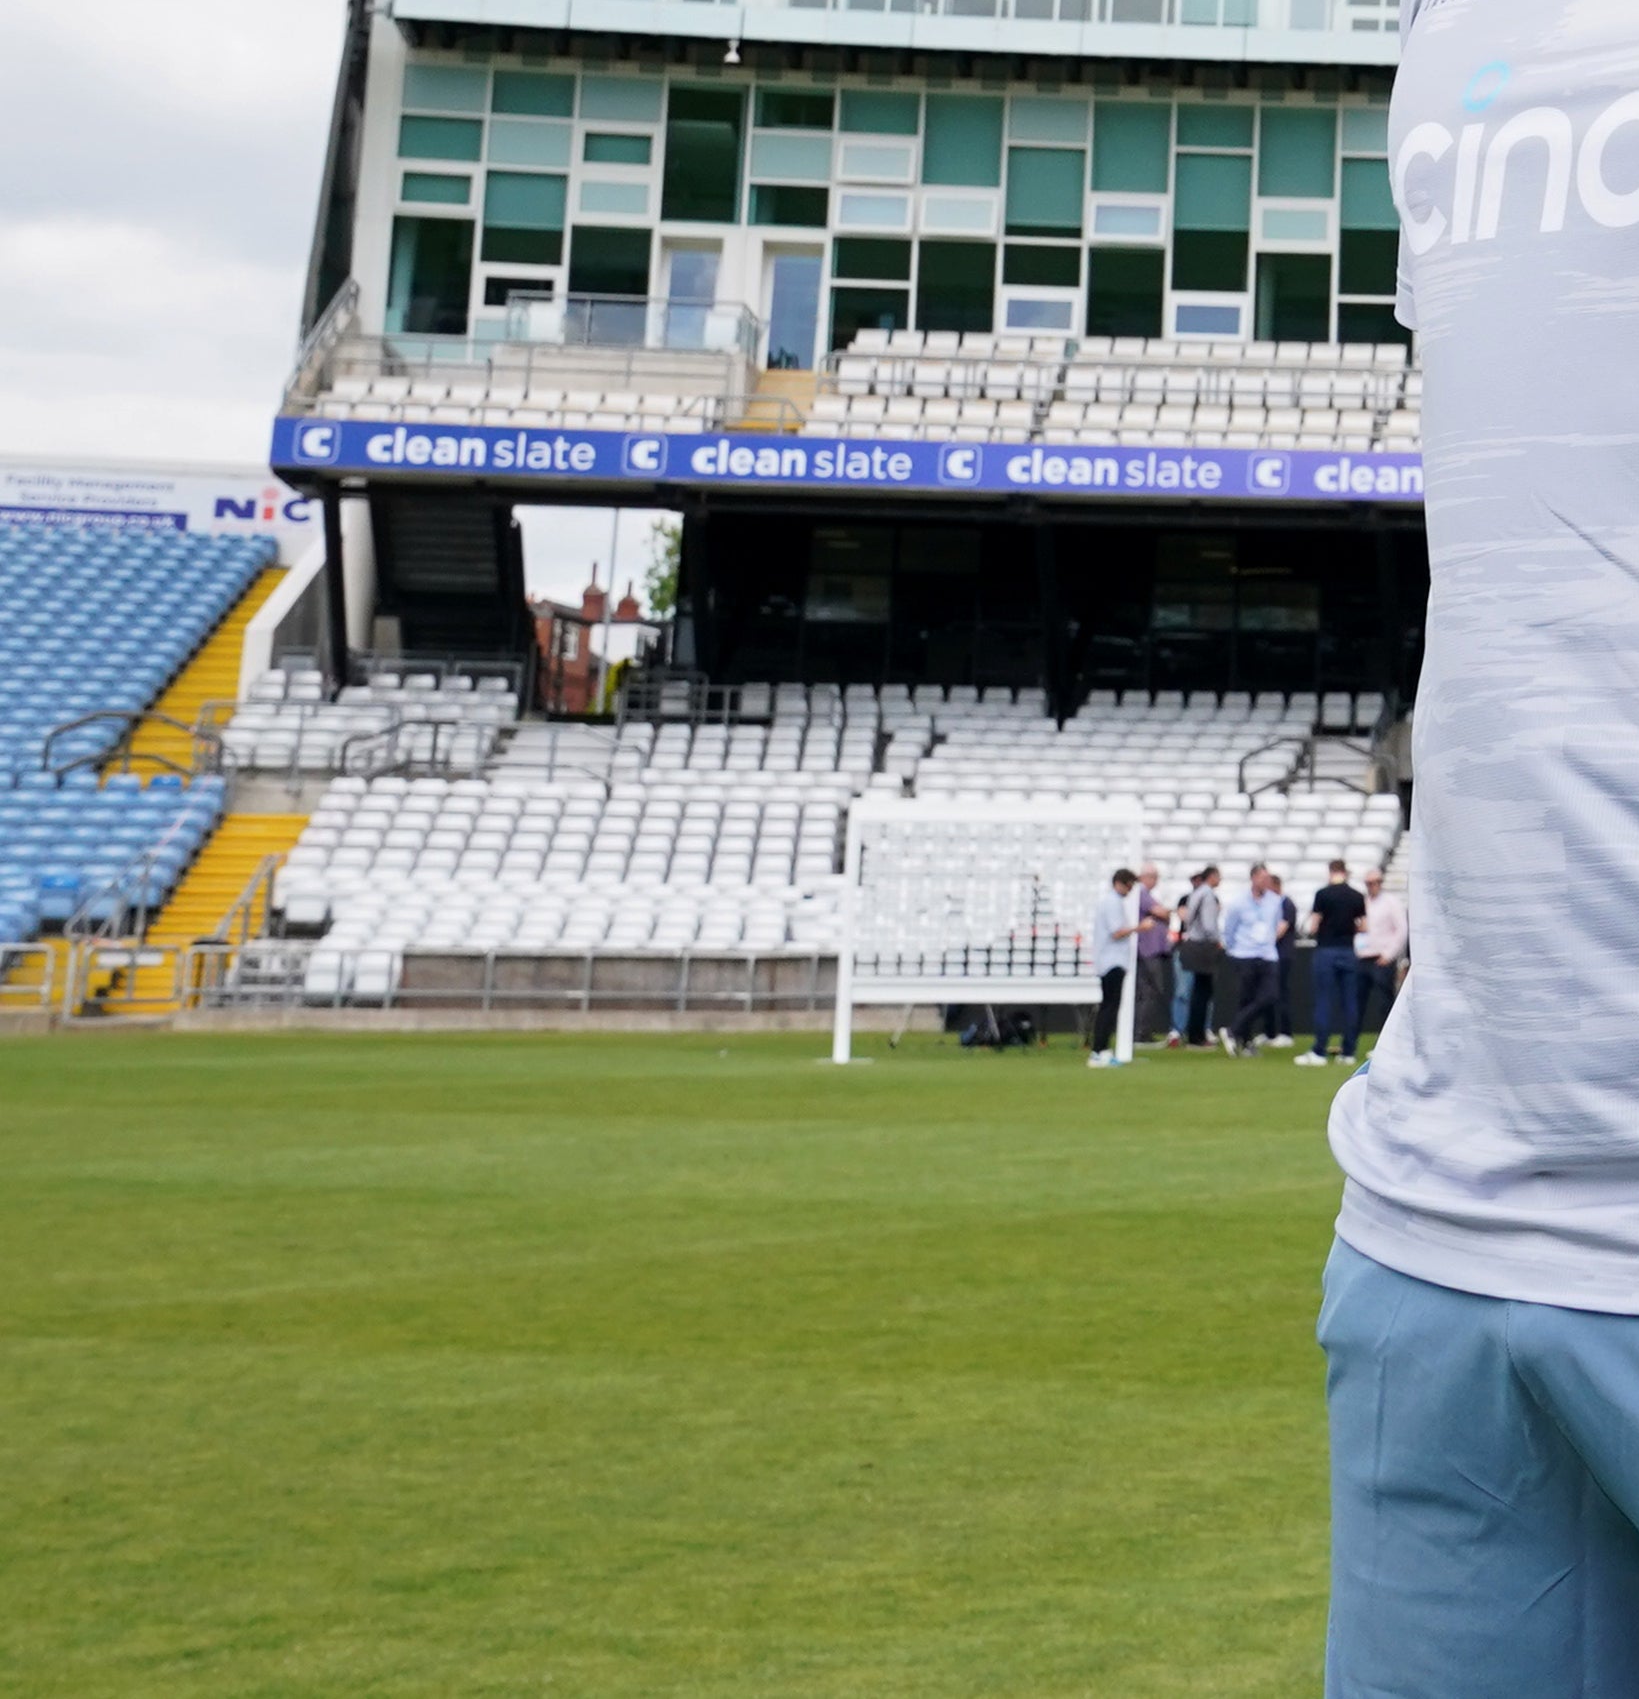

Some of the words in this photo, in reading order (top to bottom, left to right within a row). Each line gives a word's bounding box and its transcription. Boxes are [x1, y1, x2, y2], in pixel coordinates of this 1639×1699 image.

[366, 426, 487, 467] clean
[493, 431, 596, 472] slate
[691, 439, 806, 478] clean
[812, 443, 914, 482] slate
[1006, 448, 1119, 486] clean
[1124, 451, 1223, 490] slate
[1314, 457, 1424, 494] clean
